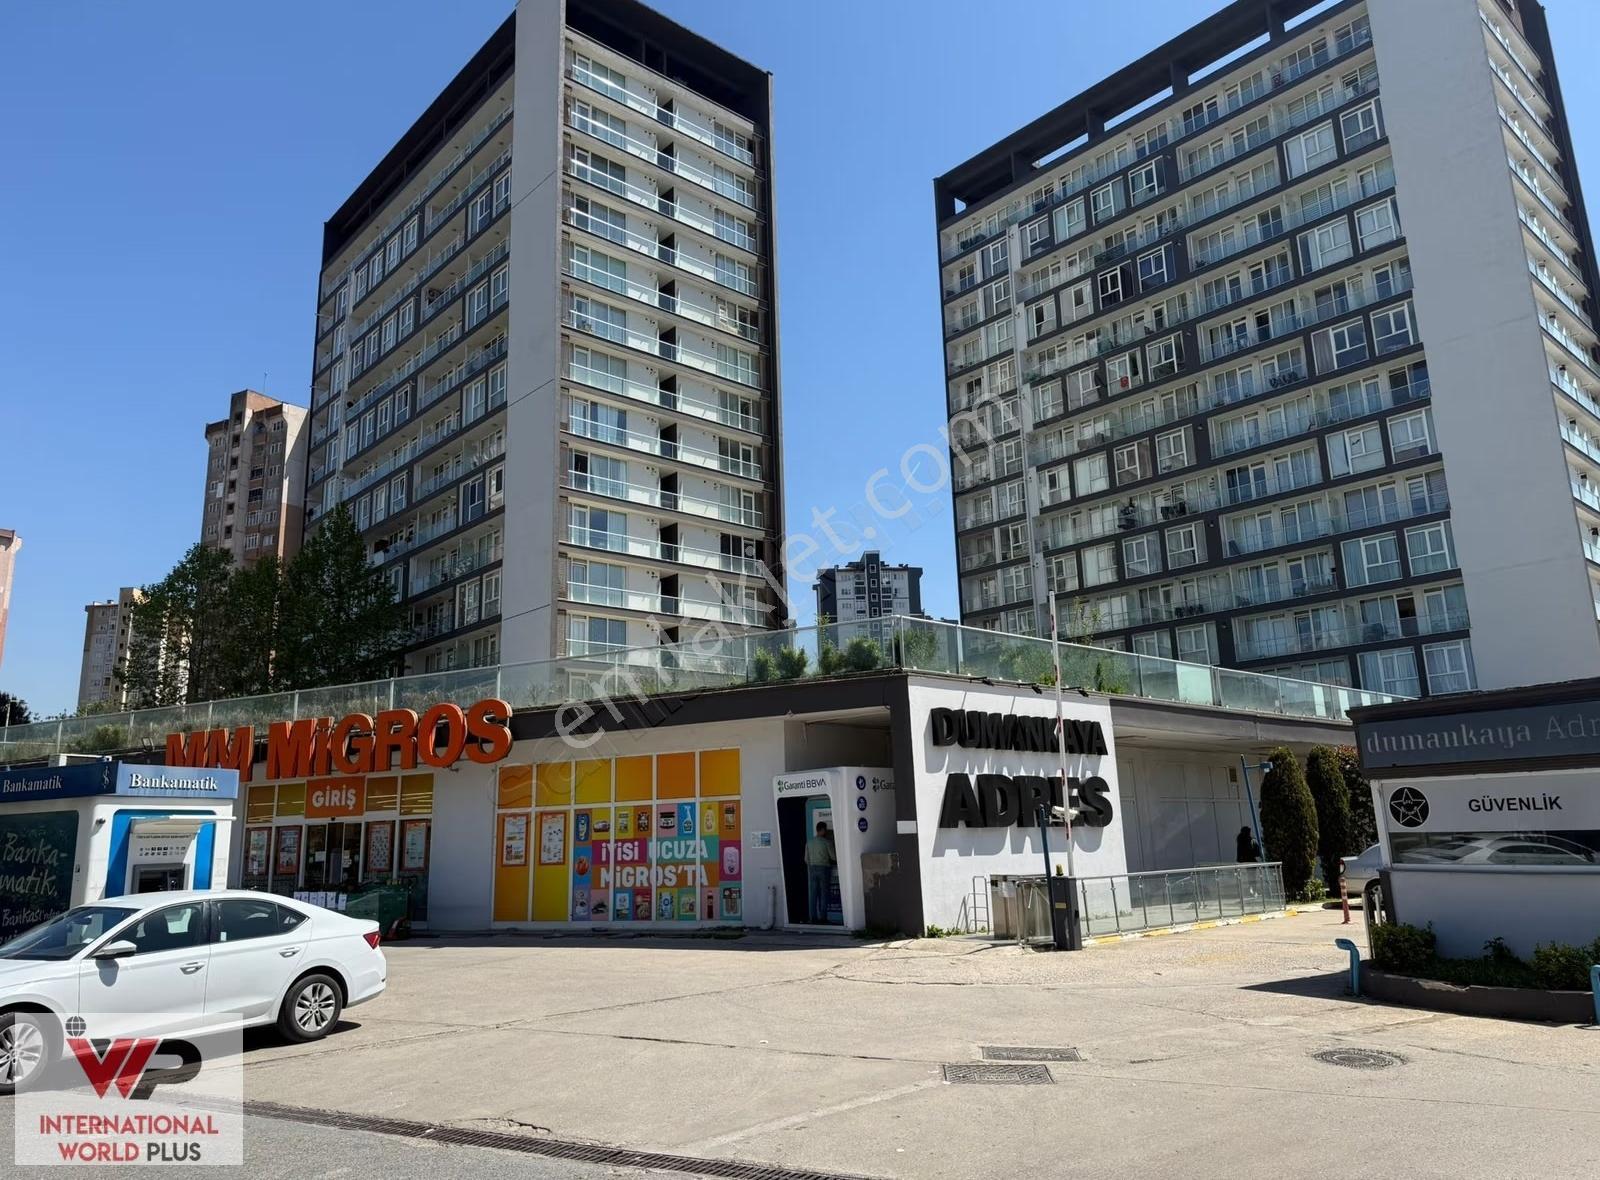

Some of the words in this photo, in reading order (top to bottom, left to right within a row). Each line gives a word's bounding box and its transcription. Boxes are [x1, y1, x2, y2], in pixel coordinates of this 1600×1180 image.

[930, 707, 1108, 755] DUMANKAYA
[1367, 723, 1531, 753] dumankaya
[165, 725, 255, 783] MM
[3, 775, 62, 793] Bankamatik
[129, 773, 218, 791] Bankamatik
[783, 780, 806, 791] Garanti
[806, 778, 826, 789] BBVA
[312, 784, 356, 809] GİRİŞ
[939, 773, 1113, 828] ADRES
[1468, 792, 1563, 813] GÜVENLİK
